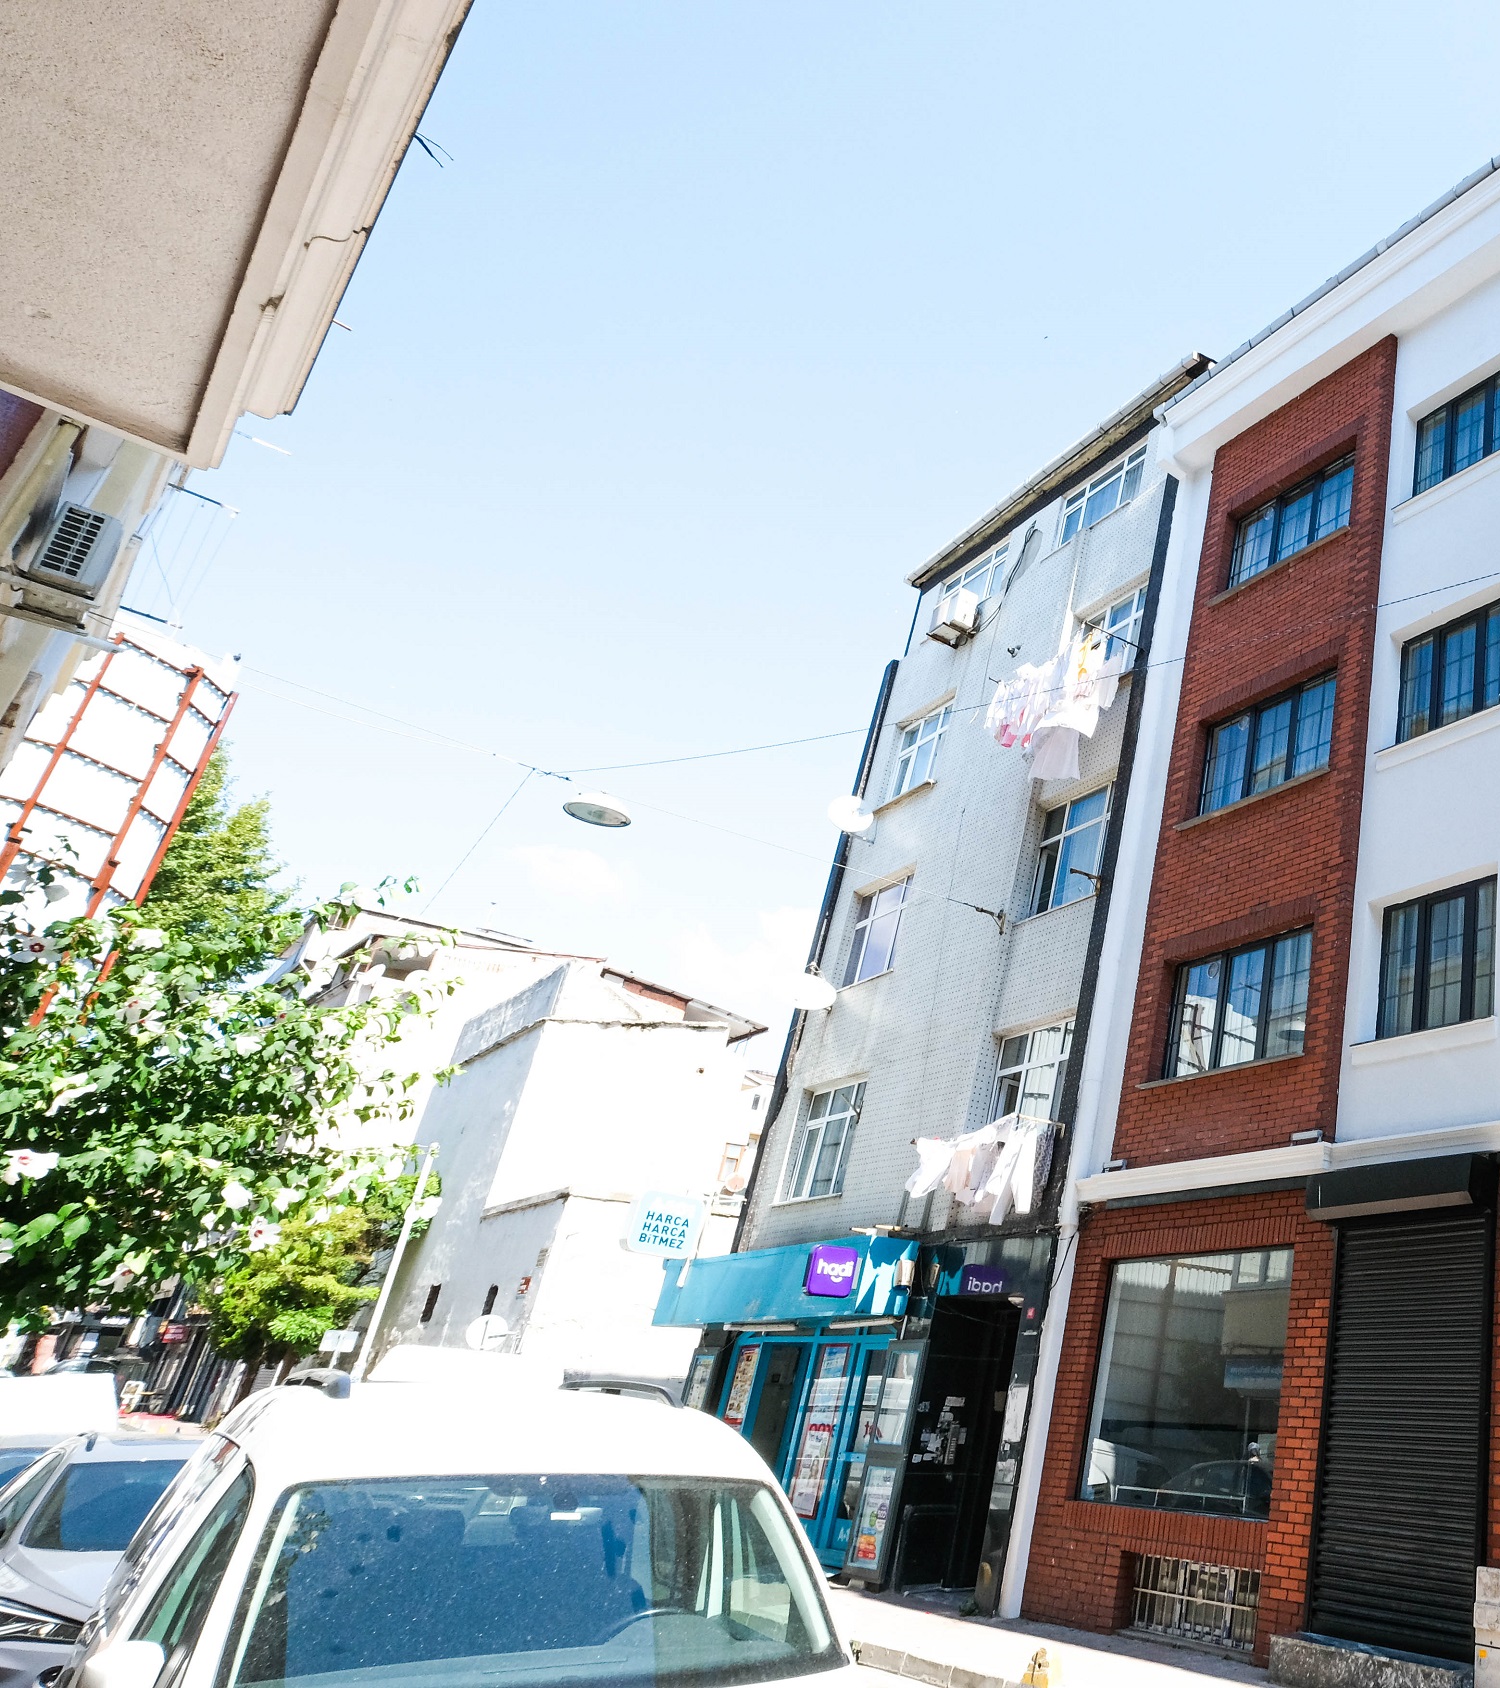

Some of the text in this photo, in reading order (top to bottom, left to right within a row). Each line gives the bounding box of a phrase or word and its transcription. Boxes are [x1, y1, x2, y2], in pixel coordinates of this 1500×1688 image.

[645, 1210, 689, 1228] HARCA
[642, 1221, 686, 1238] HARCA
[816, 1258, 855, 1278] hadi
